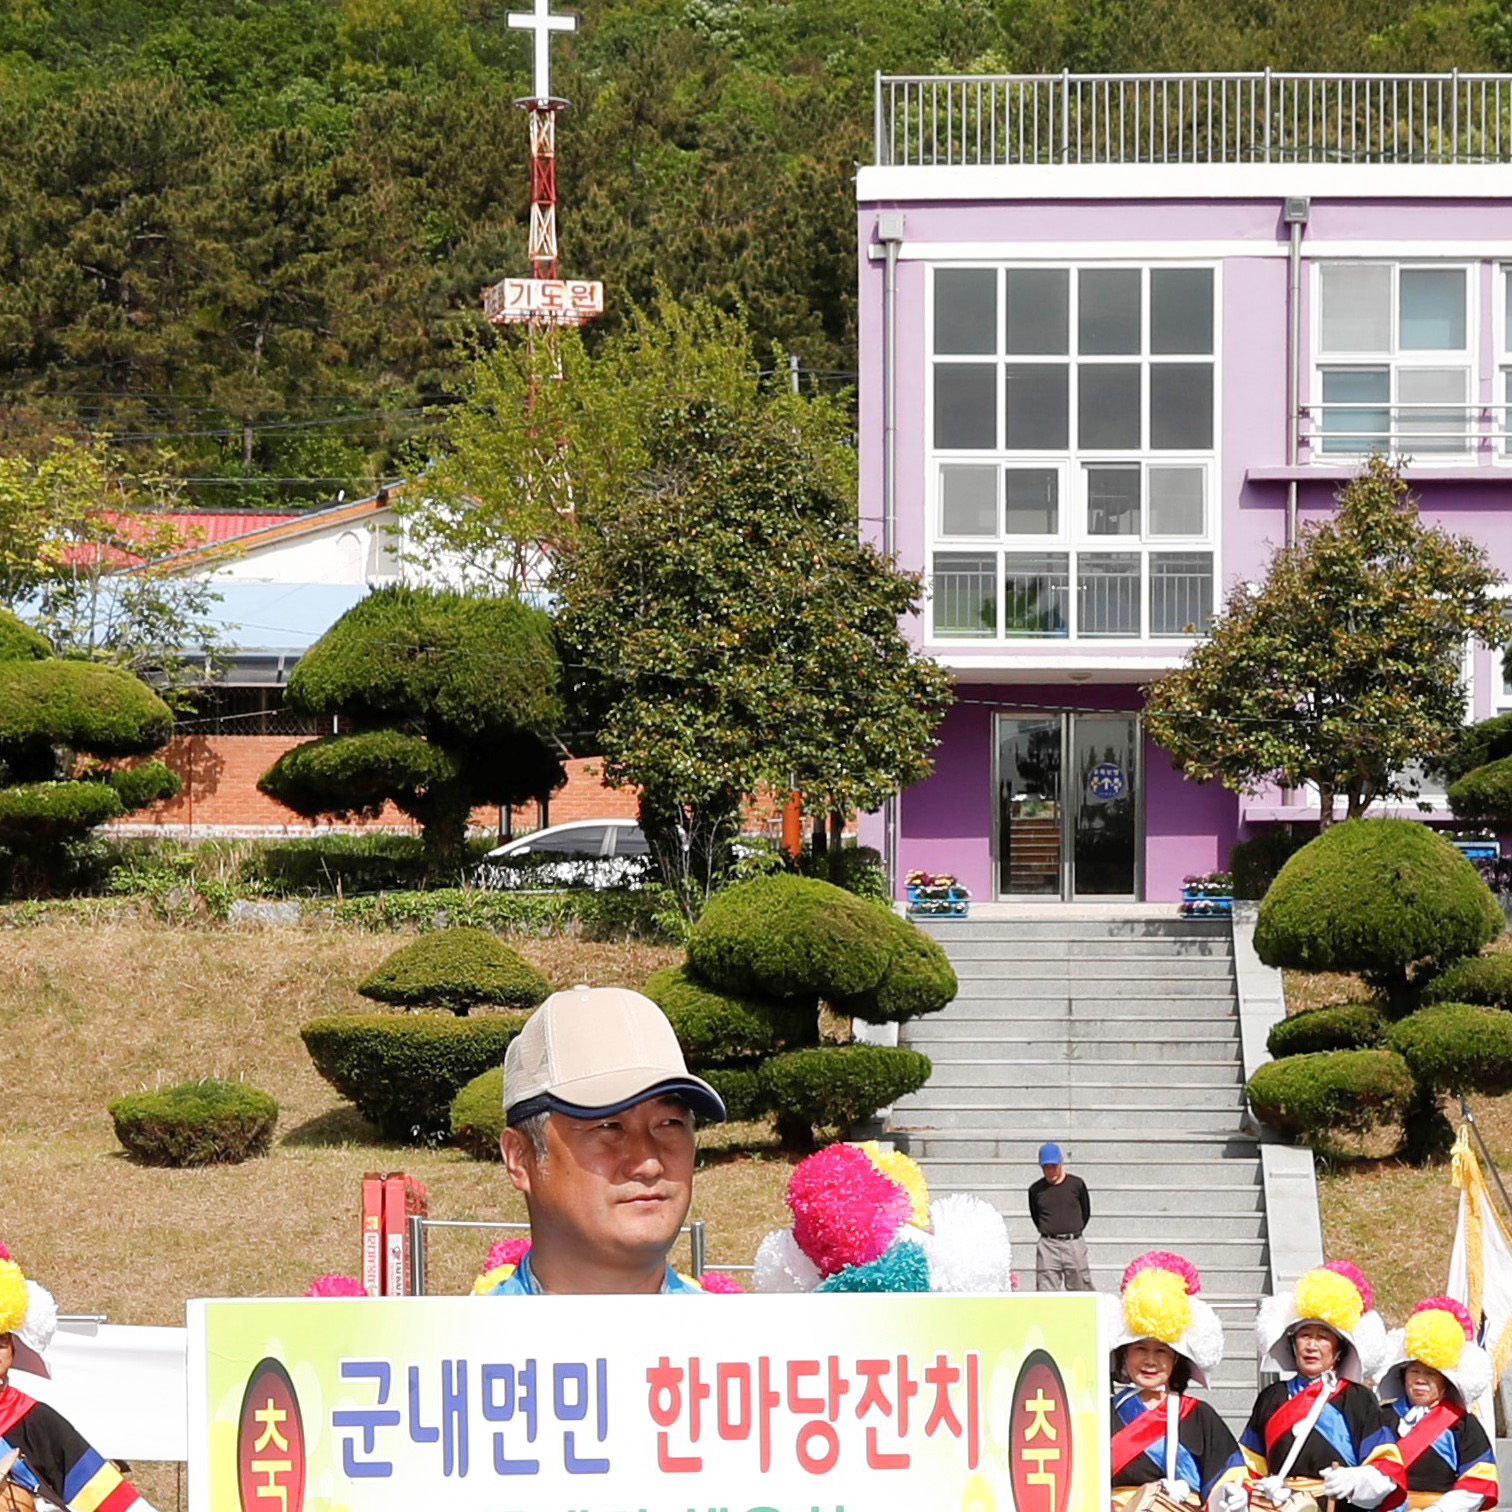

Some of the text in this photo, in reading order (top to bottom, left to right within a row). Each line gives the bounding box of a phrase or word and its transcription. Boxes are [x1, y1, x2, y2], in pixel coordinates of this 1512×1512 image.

[509, 283, 596, 309] 기도원
[332, 1353, 981, 1480] 군내면민 한마당잔치
